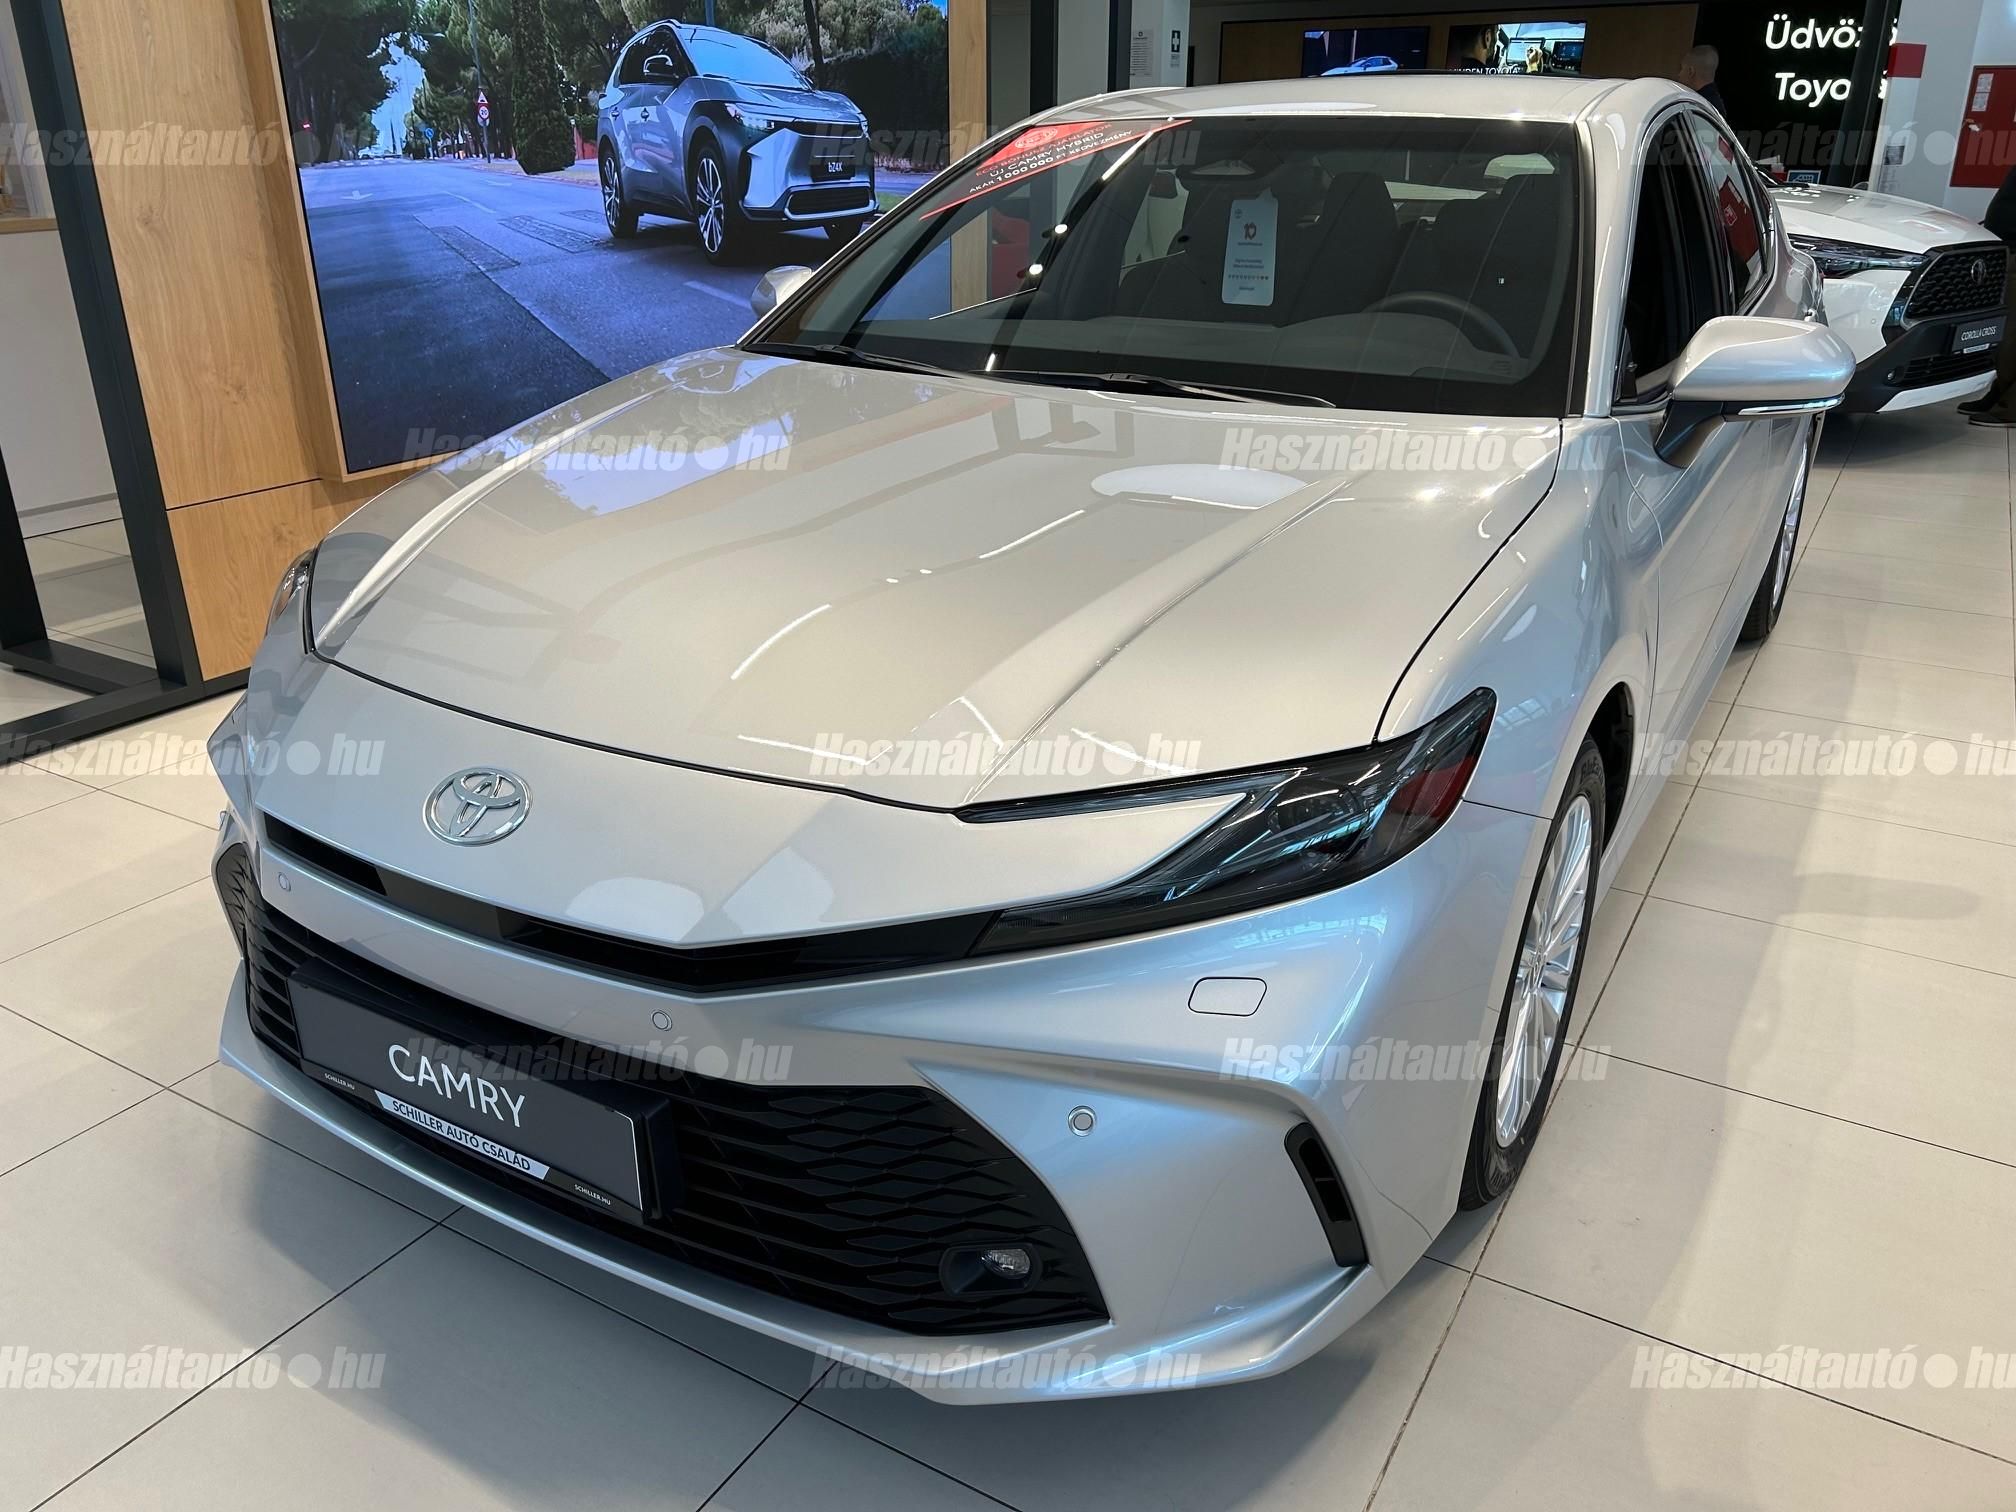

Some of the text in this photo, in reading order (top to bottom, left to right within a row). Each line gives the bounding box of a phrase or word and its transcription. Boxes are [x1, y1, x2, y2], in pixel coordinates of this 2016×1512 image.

[1765, 13, 1897, 49] Üdvö
[1774, 70, 1888, 107] Toyo
[1008, 150, 1053, 171] CAMRY
[1056, 132, 1104, 153] HYBRID
[388, 1044, 526, 1128] CAMRY
[392, 1100, 530, 1171] SCHILLER AUTÓ CSALÁD
[574, 1183, 611, 1206] SCHILLER.HU
